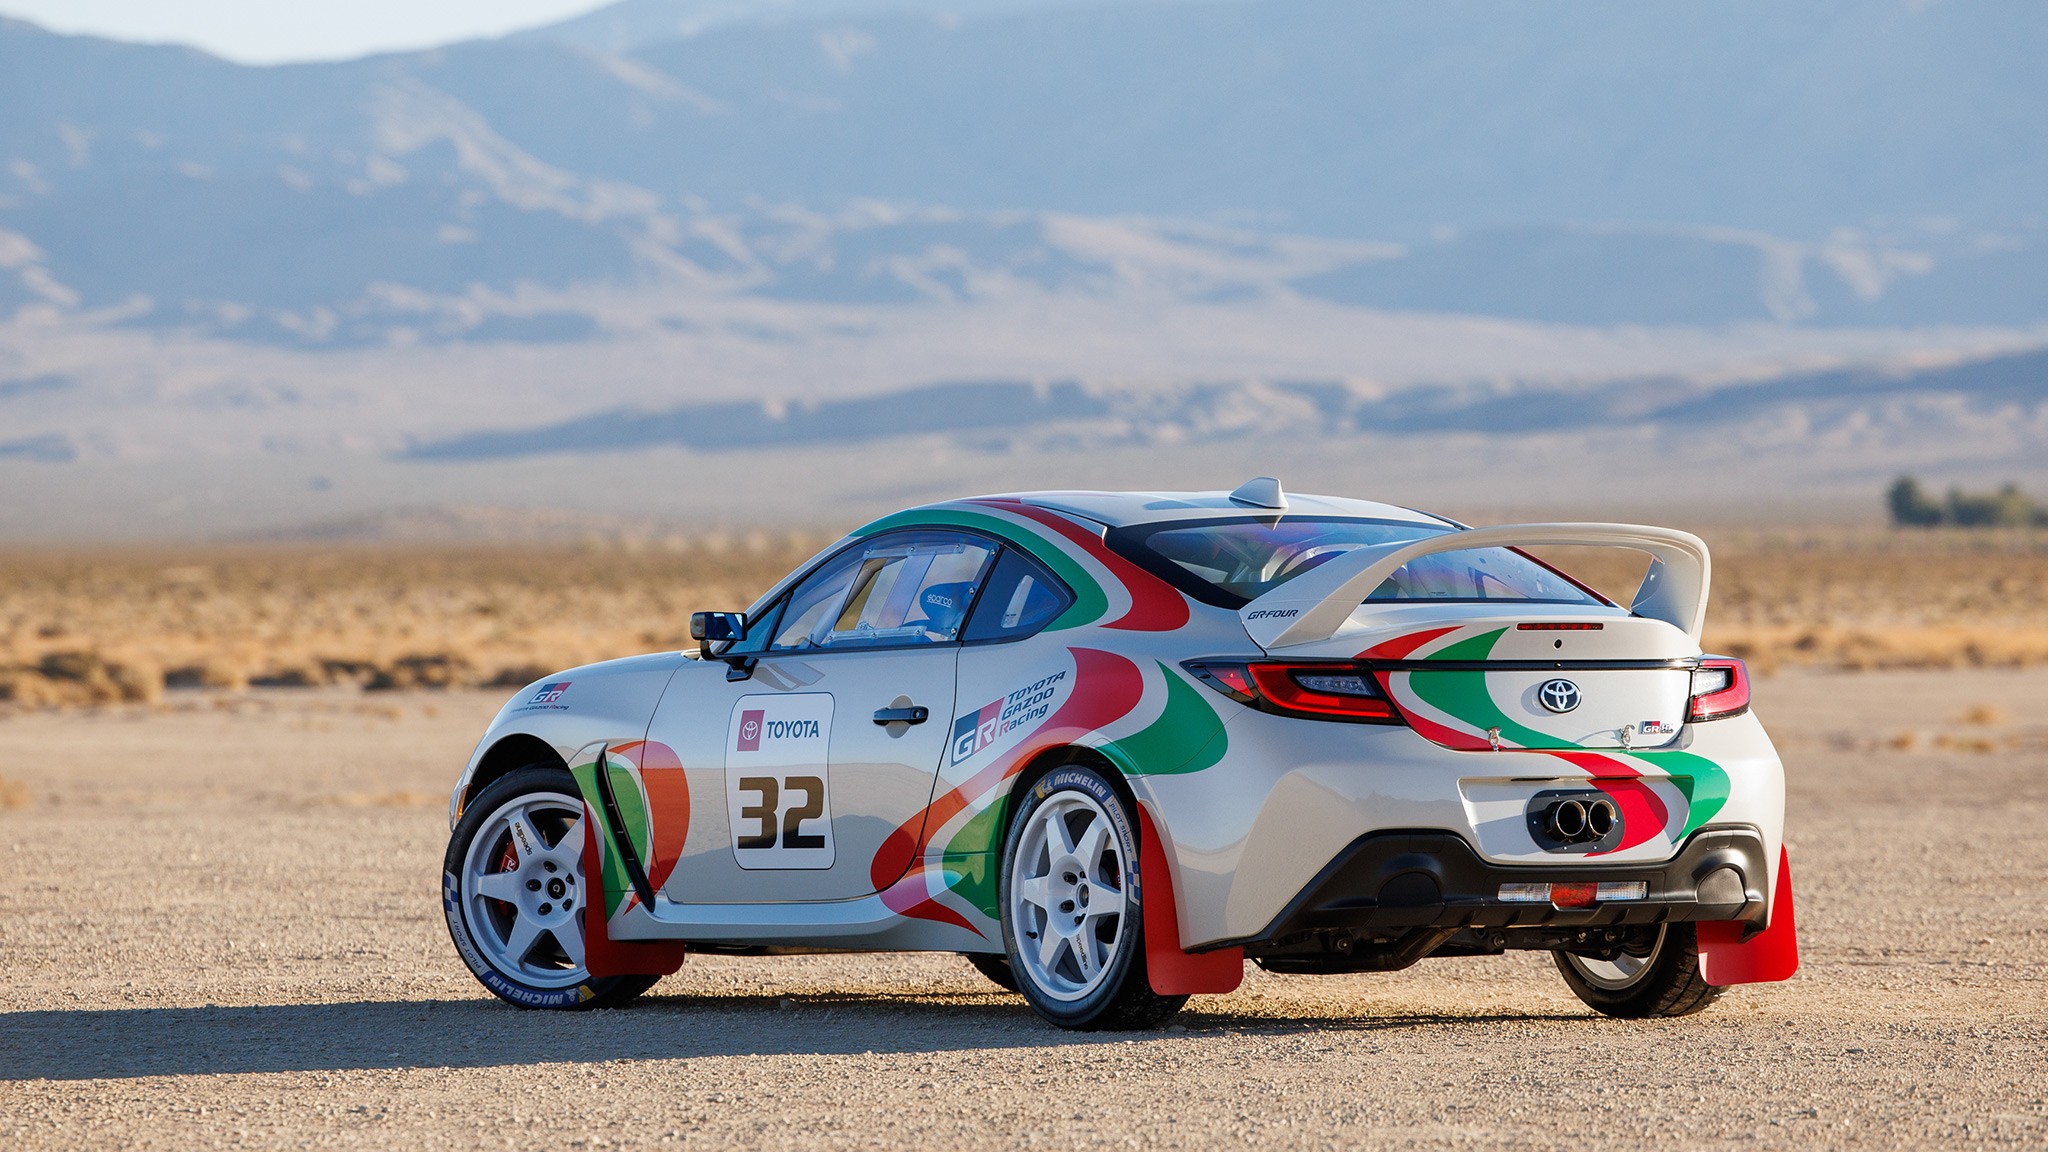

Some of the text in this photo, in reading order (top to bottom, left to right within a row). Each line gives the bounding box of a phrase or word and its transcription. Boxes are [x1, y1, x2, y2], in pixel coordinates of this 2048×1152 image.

[927, 594, 953, 608] sparco
[530, 690, 564, 703] GR
[1001, 687, 1055, 721] GAZOO
[1008, 671, 1067, 705] TOYOTA
[767, 720, 820, 739] TOYOTA
[999, 703, 1049, 737] Racing
[953, 717, 997, 762] GR
[1054, 772, 1107, 798] MICHELIN
[737, 776, 826, 850] 32
[1109, 803, 1132, 853] PILOT SPORT
[515, 822, 533, 856] speedline
[453, 919, 564, 1005] MICHELIN PILOT SPORT
